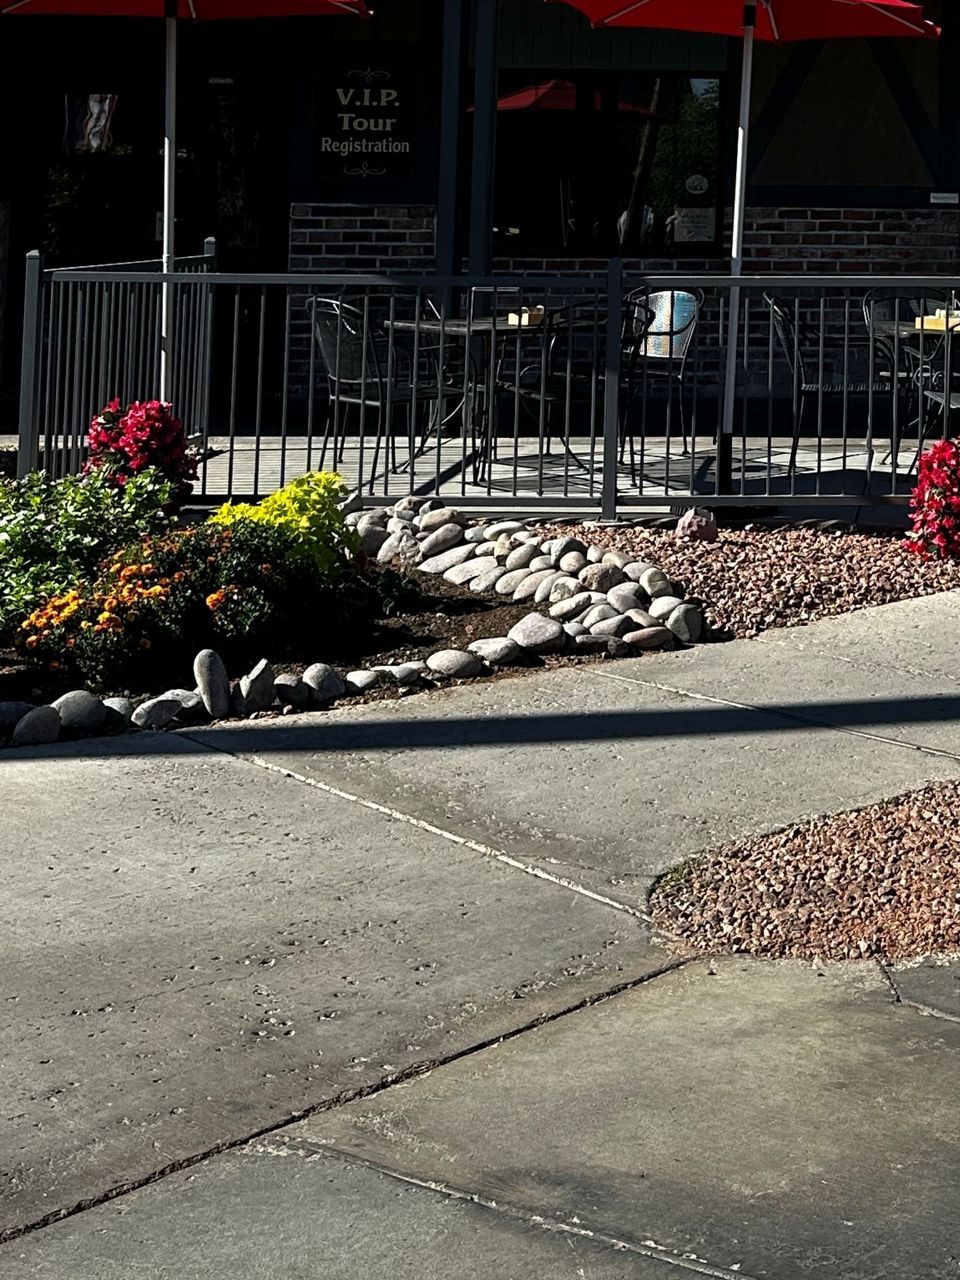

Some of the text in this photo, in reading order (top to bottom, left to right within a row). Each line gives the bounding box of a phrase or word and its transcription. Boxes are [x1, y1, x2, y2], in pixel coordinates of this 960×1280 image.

[336, 88, 400, 107] V.I.P.
[337, 113, 397, 131] Tour
[321, 137, 410, 157] Registration
